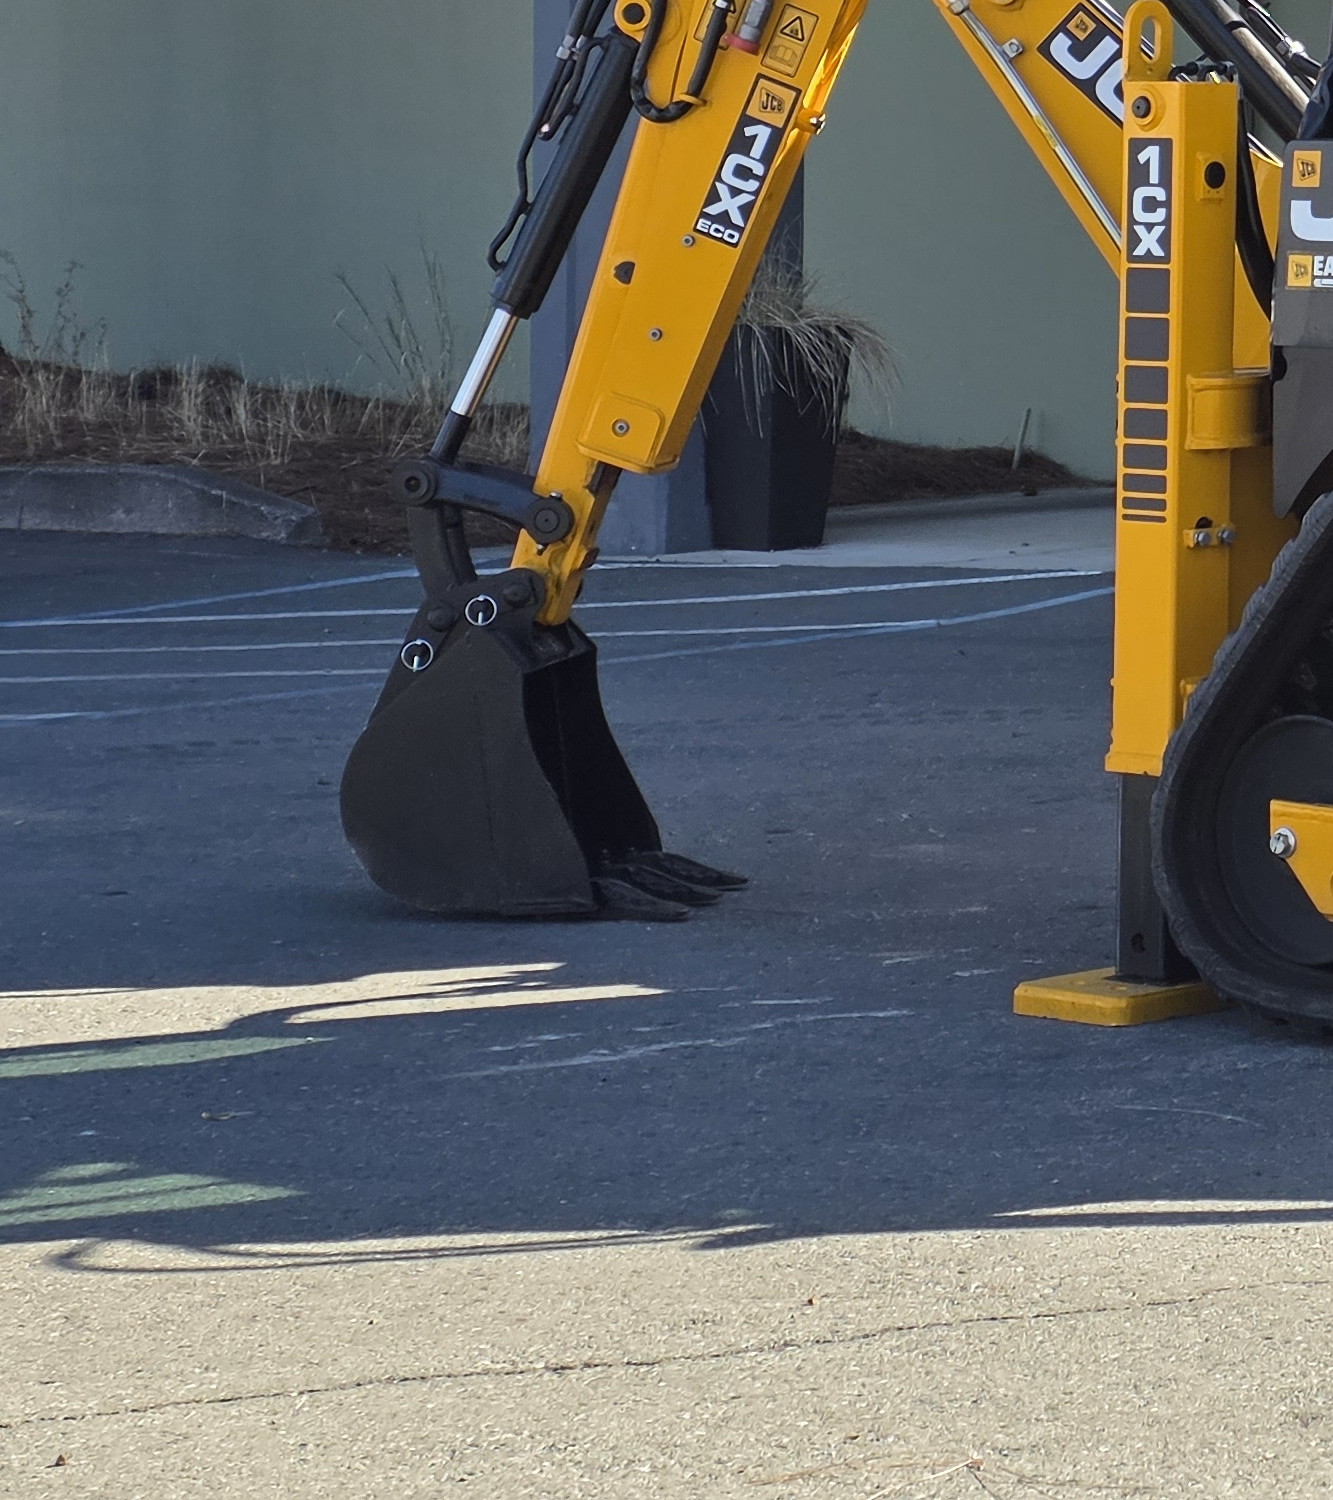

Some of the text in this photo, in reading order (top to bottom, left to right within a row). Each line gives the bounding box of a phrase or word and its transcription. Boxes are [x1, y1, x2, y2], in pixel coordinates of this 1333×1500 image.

[762, 92, 783, 111] JCB
[702, 124, 772, 227] 1CX
[1132, 145, 1166, 257] 1CX
[695, 218, 740, 244] ECO
